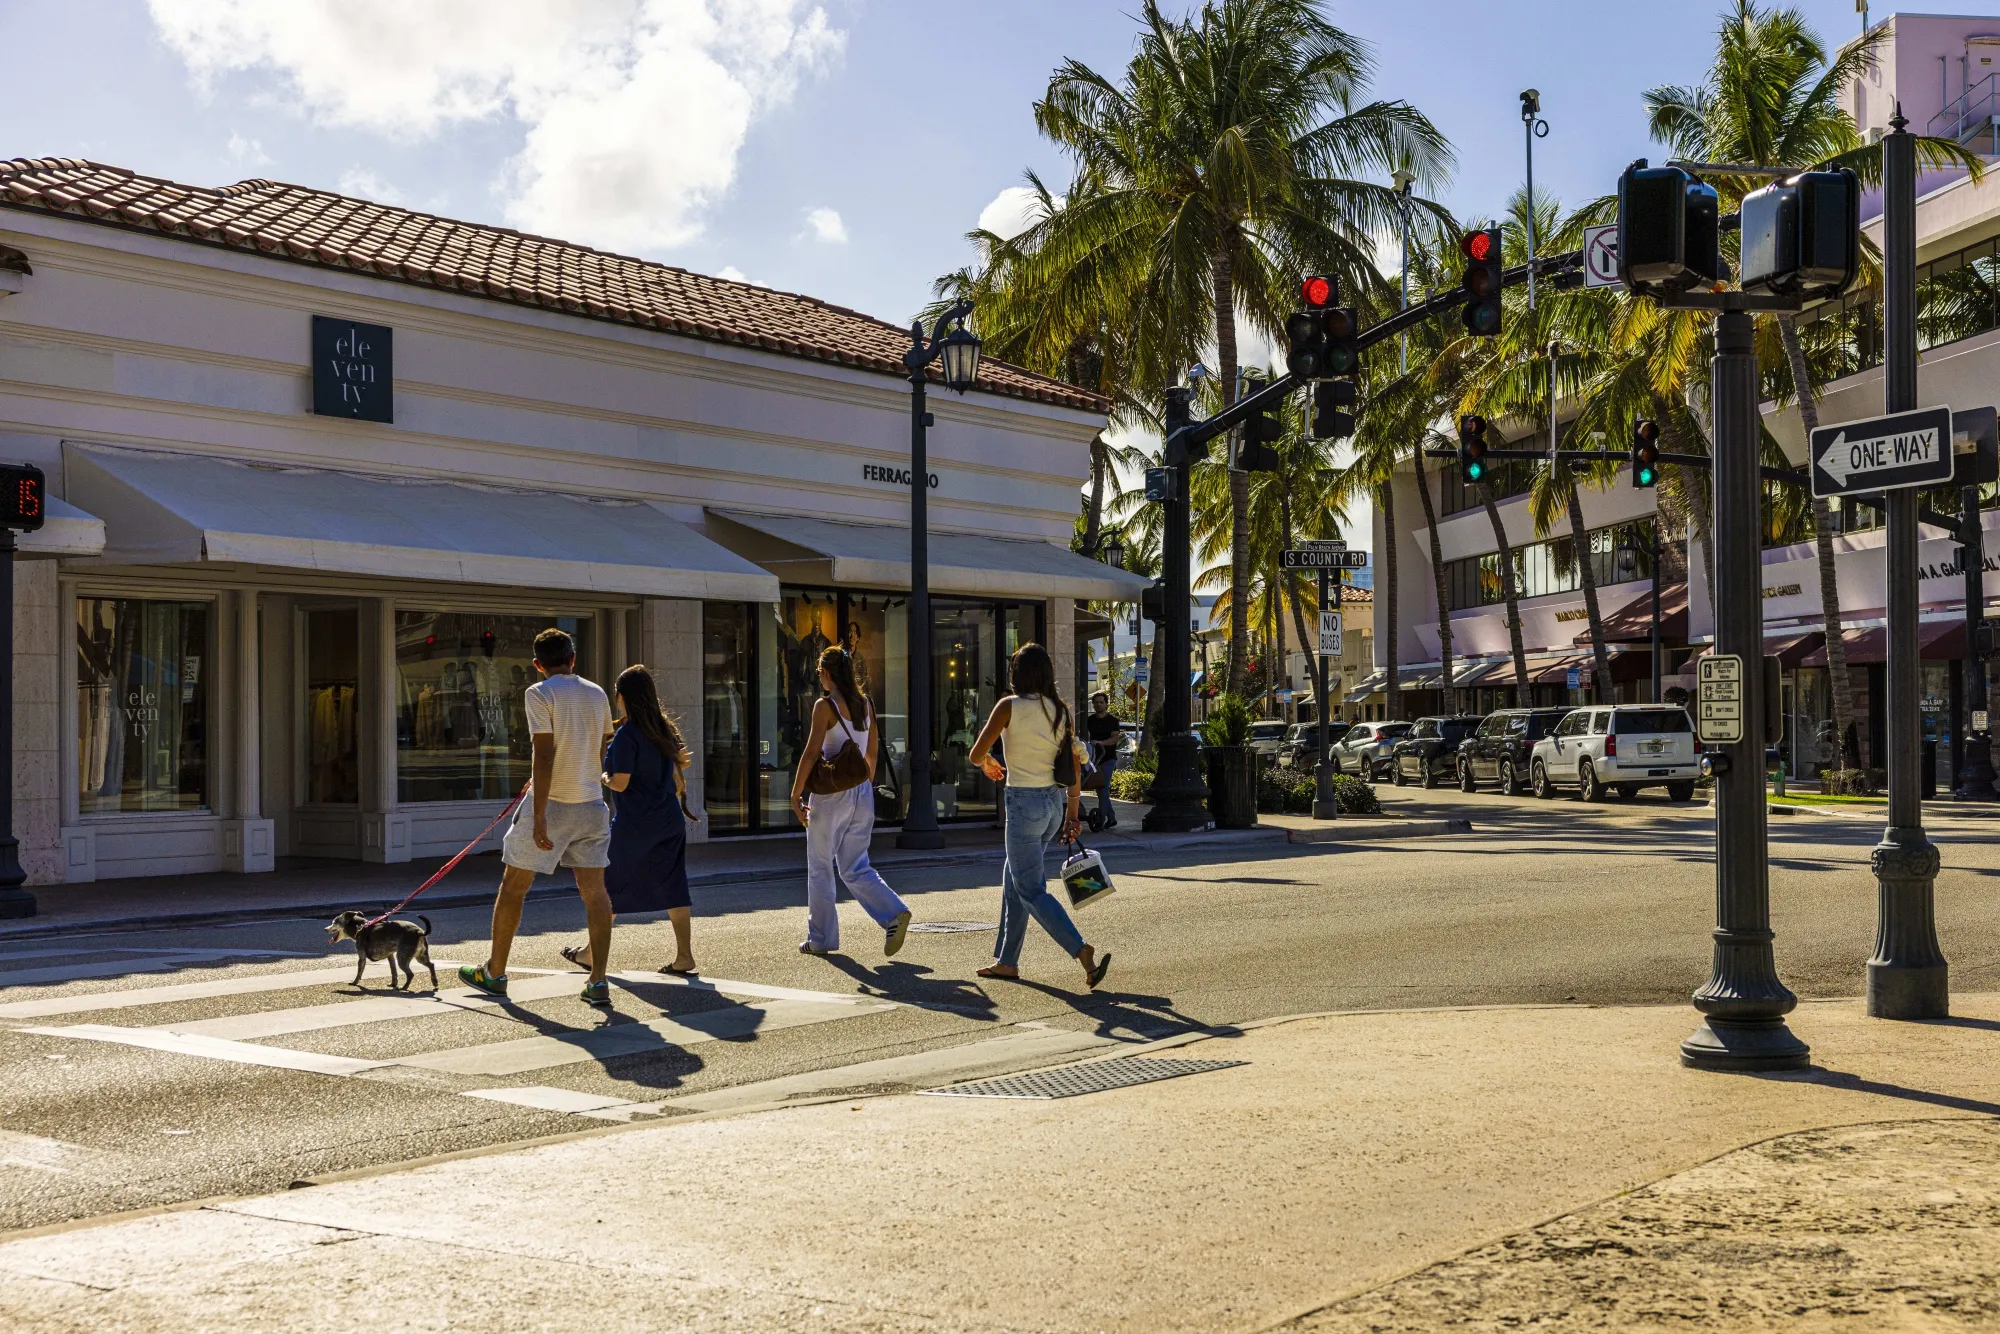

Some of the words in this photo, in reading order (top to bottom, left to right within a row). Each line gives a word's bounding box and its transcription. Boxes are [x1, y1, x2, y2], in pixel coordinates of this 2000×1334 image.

[336, 328, 371, 360] ele
[331, 359, 375, 383] ven
[1850, 440, 1887, 470] ONE
[1893, 432, 1933, 463] WAY
[19, 479, 39, 516] 15
[1288, 552, 1295, 565] S
[1301, 552, 1345, 566] COUNTY
[1351, 552, 1365, 566] RD
[1323, 614, 1338, 632] NO
[1321, 633, 1340, 651] BUSES
[128, 684, 156, 706] ele
[481, 689, 501, 708] ele
[125, 708, 159, 721] ven
[478, 709, 504, 721] ven
[1062, 863, 1085, 878] ARITZIA
